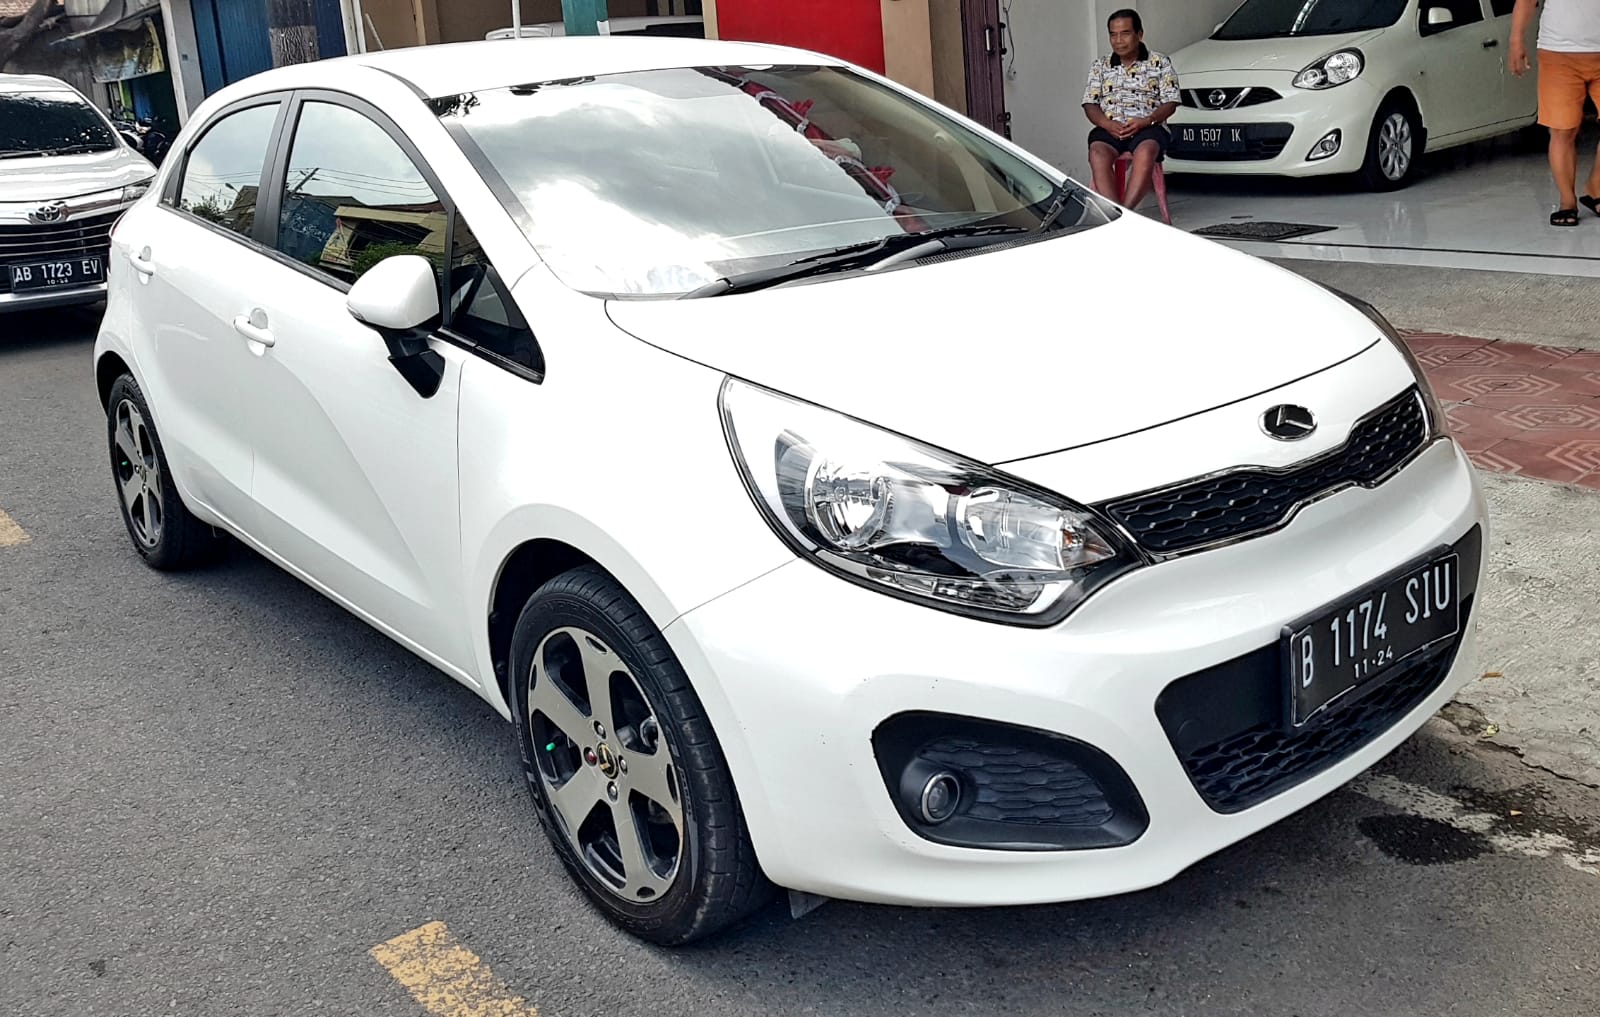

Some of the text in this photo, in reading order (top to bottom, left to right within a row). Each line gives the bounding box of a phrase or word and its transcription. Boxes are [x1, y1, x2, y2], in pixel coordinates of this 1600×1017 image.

[1183, 128, 1241, 142] AD 1507 IK
[15, 259, 98, 283] AB 1723 EV
[1301, 563, 1450, 688] B 1174 SIU
